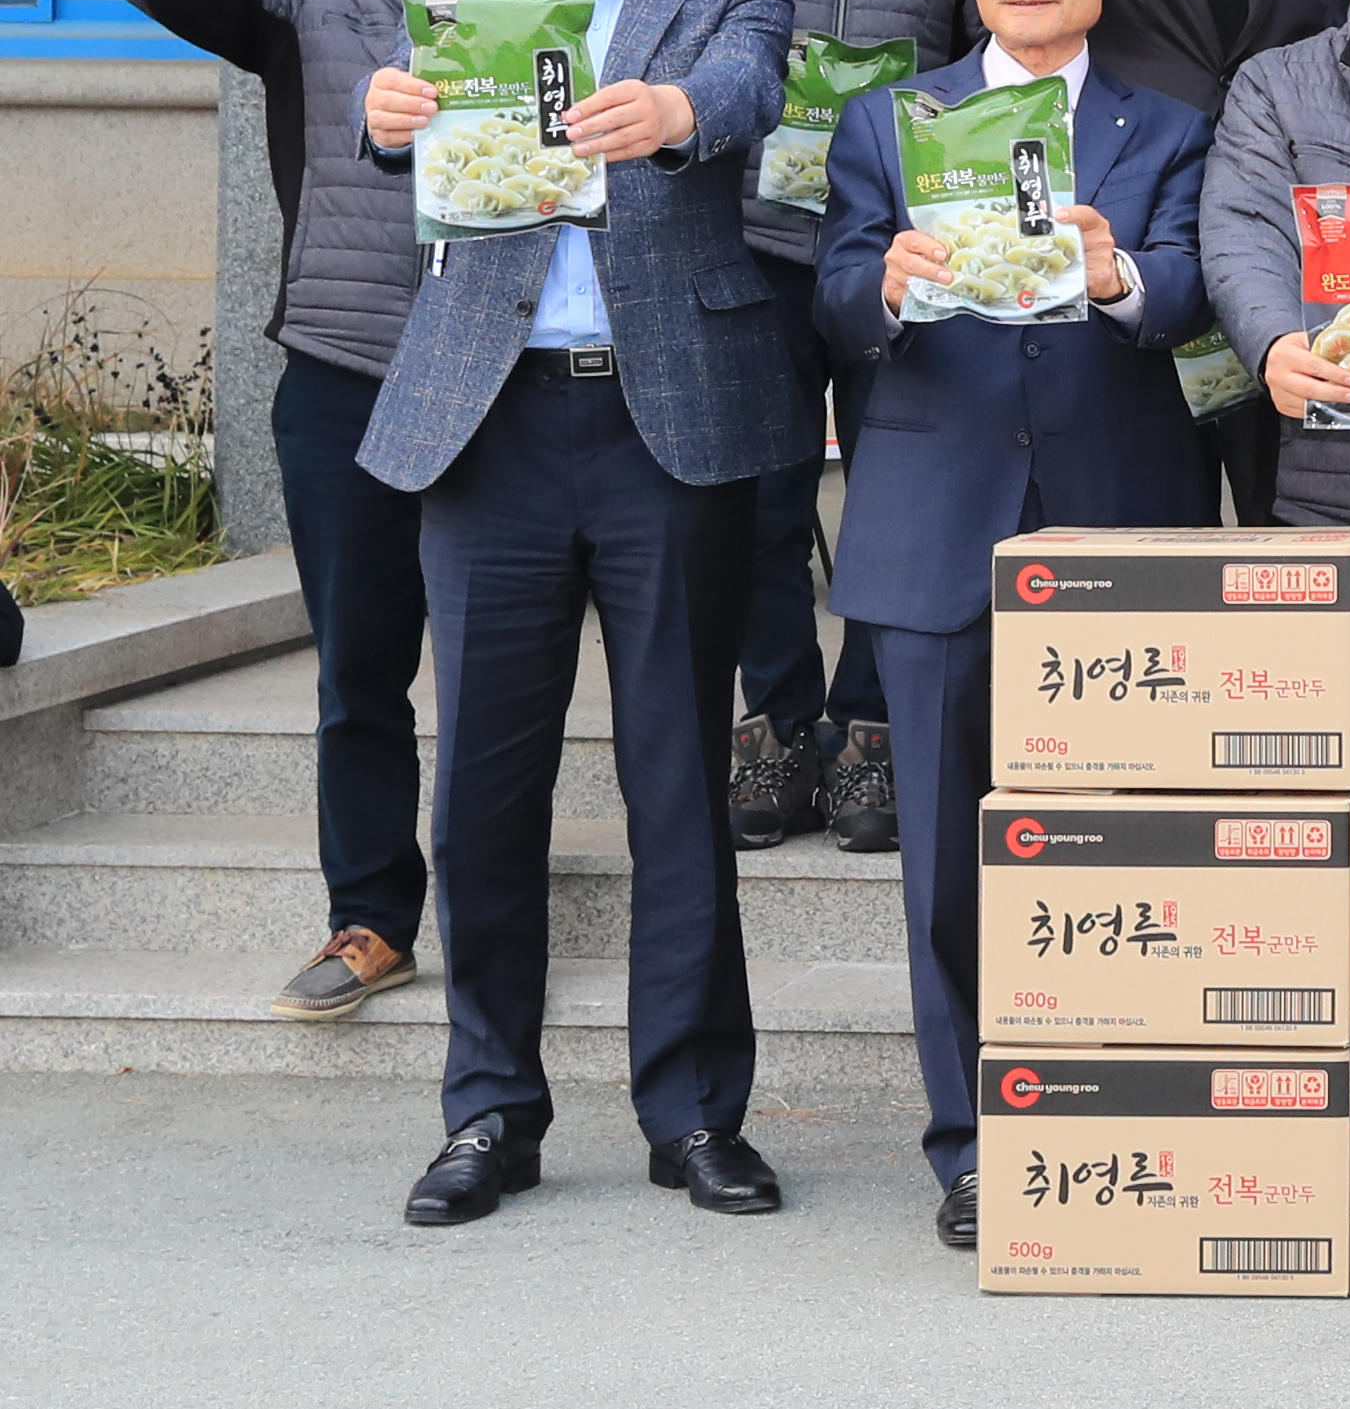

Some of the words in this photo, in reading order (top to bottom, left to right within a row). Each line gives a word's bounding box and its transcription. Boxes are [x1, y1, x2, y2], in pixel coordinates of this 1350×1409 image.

[542, 58, 568, 138] 취영루
[916, 168, 1009, 194] 완도전복물만두
[1018, 149, 1047, 228] 취영루
[1030, 578, 1057, 588] chew
[1059, 580, 1093, 591] young
[1093, 580, 1113, 588] roo
[1038, 646, 1187, 703] 취영루
[1221, 669, 1325, 700] 전복군만두
[1160, 690, 1188, 704] 지존의
[1190, 690, 1211, 704] 귀환
[1025, 738, 1067, 755] 500g
[1028, 901, 1179, 957] 취영루
[1212, 925, 1318, 955] 전복군만두
[1015, 1082, 1043, 1093] chew
[1045, 1084, 1080, 1095] young
[1080, 1084, 1100, 1093] roo
[1023, 1150, 1175, 1207] 취영루
[1209, 1175, 1315, 1205] 전복군만두
[1010, 1242, 1052, 1259] 500g
